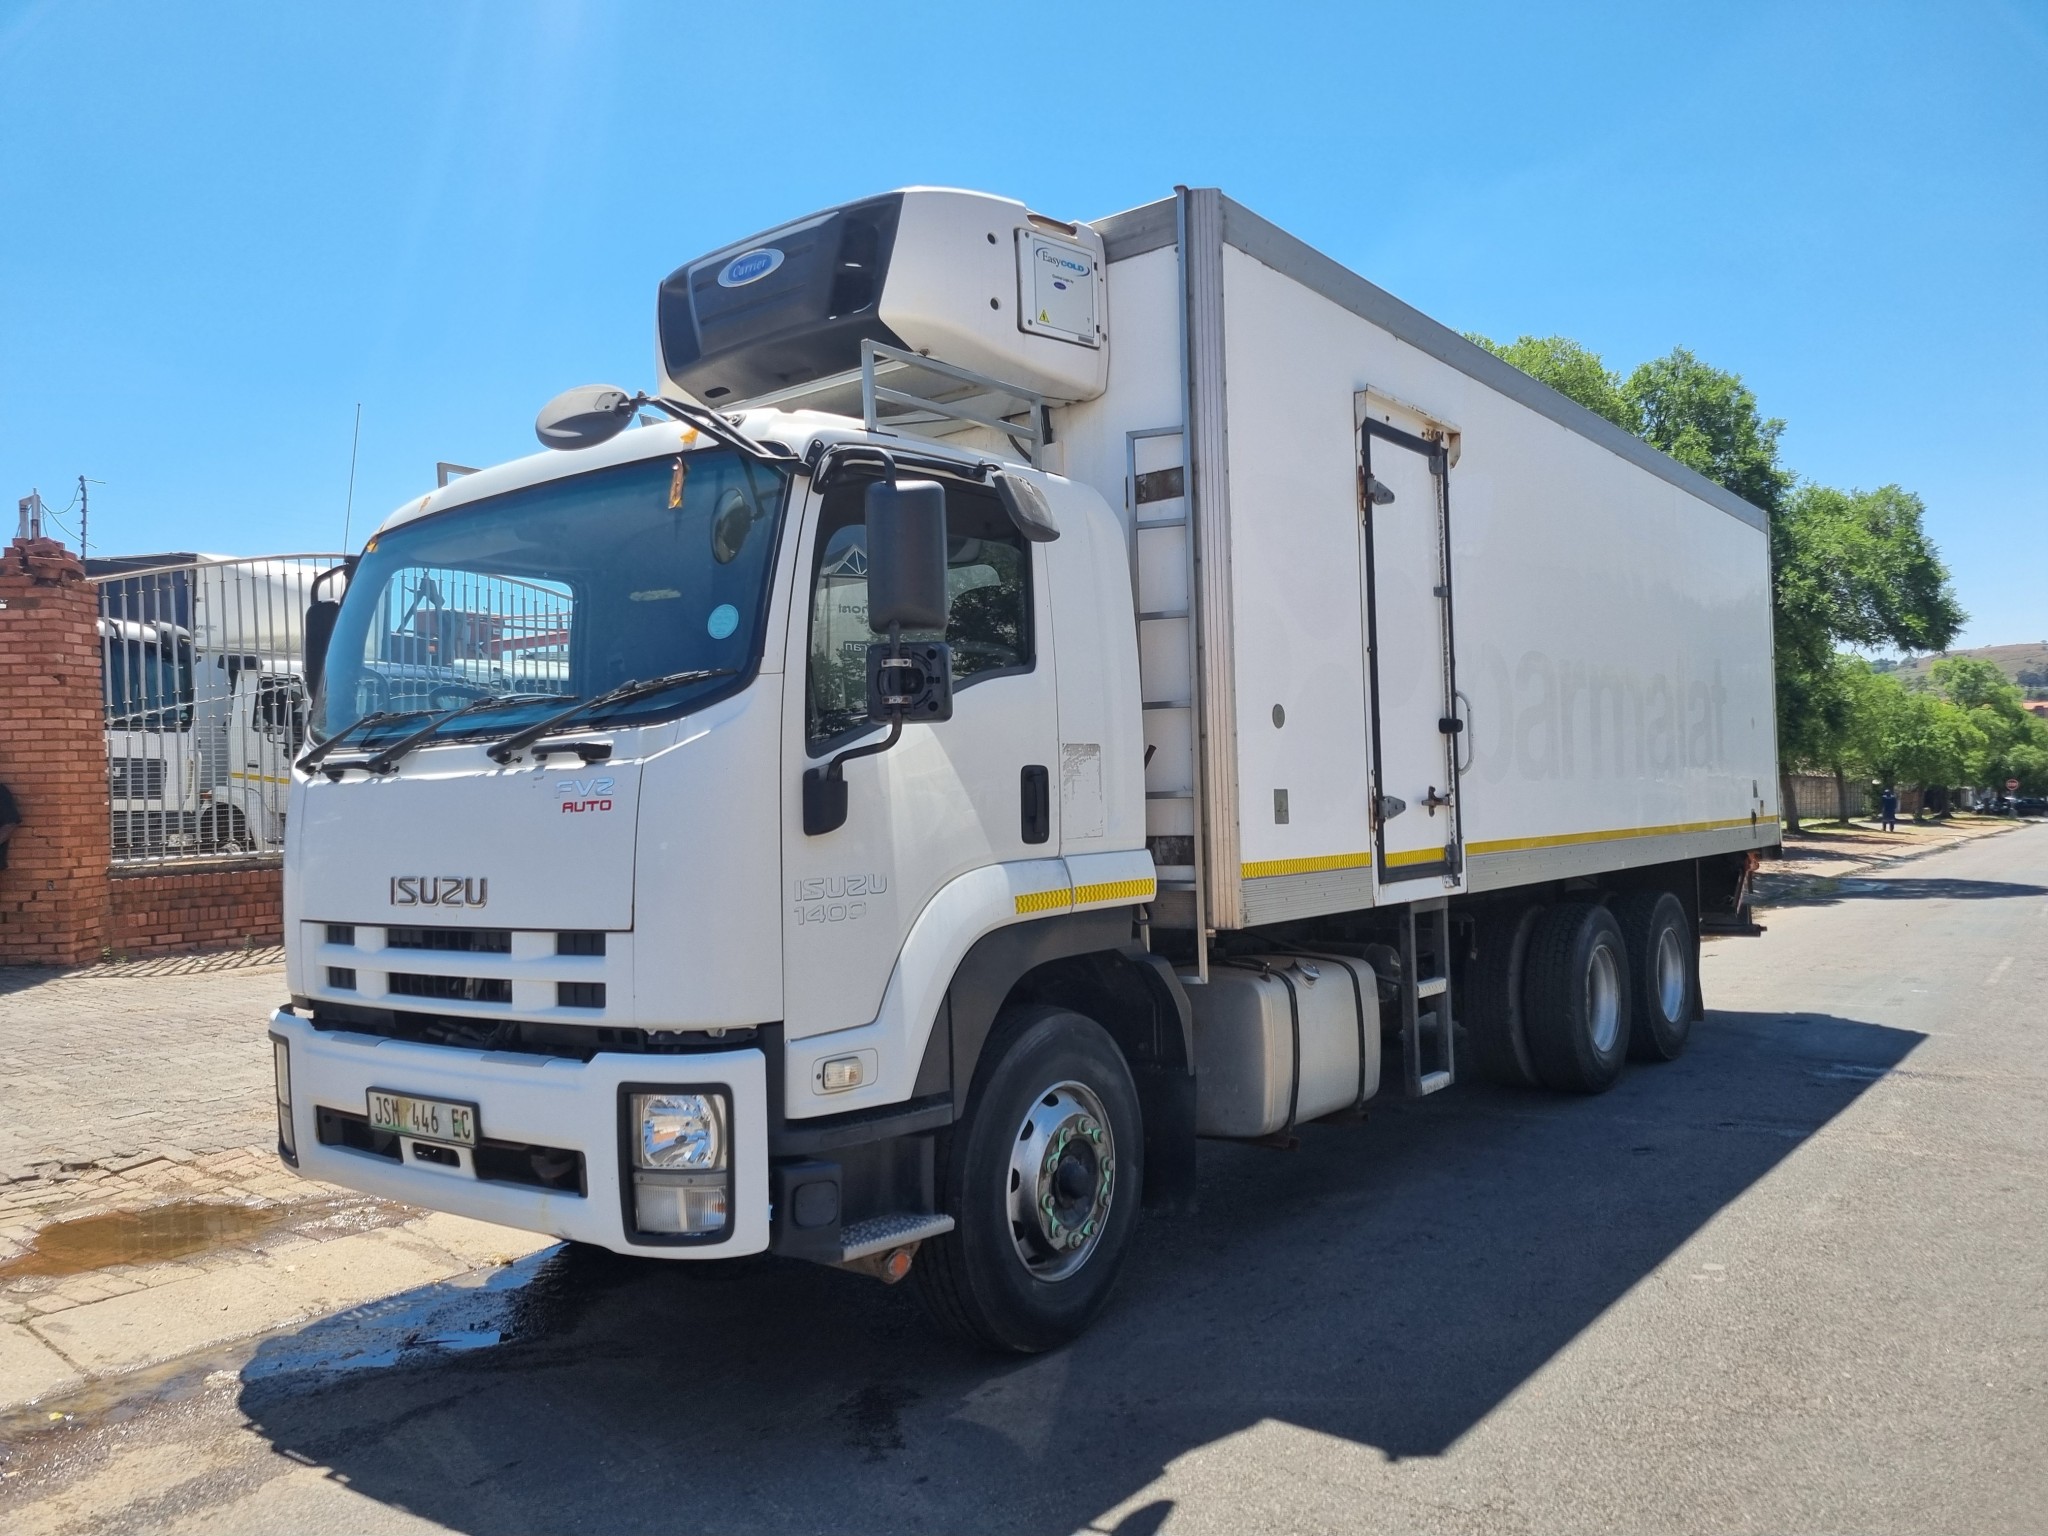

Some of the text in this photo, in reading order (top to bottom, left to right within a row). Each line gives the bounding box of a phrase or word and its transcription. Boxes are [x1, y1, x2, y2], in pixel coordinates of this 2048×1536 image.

[732, 258, 767, 279] Carrier
[1042, 250, 1085, 272] EasyCOLD
[562, 799, 612, 813] AUTO
[390, 876, 488, 908] ISUZU
[793, 873, 888, 901] ISUZU
[412, 1103, 439, 1134] 446
[451, 1108, 471, 1139] EC
